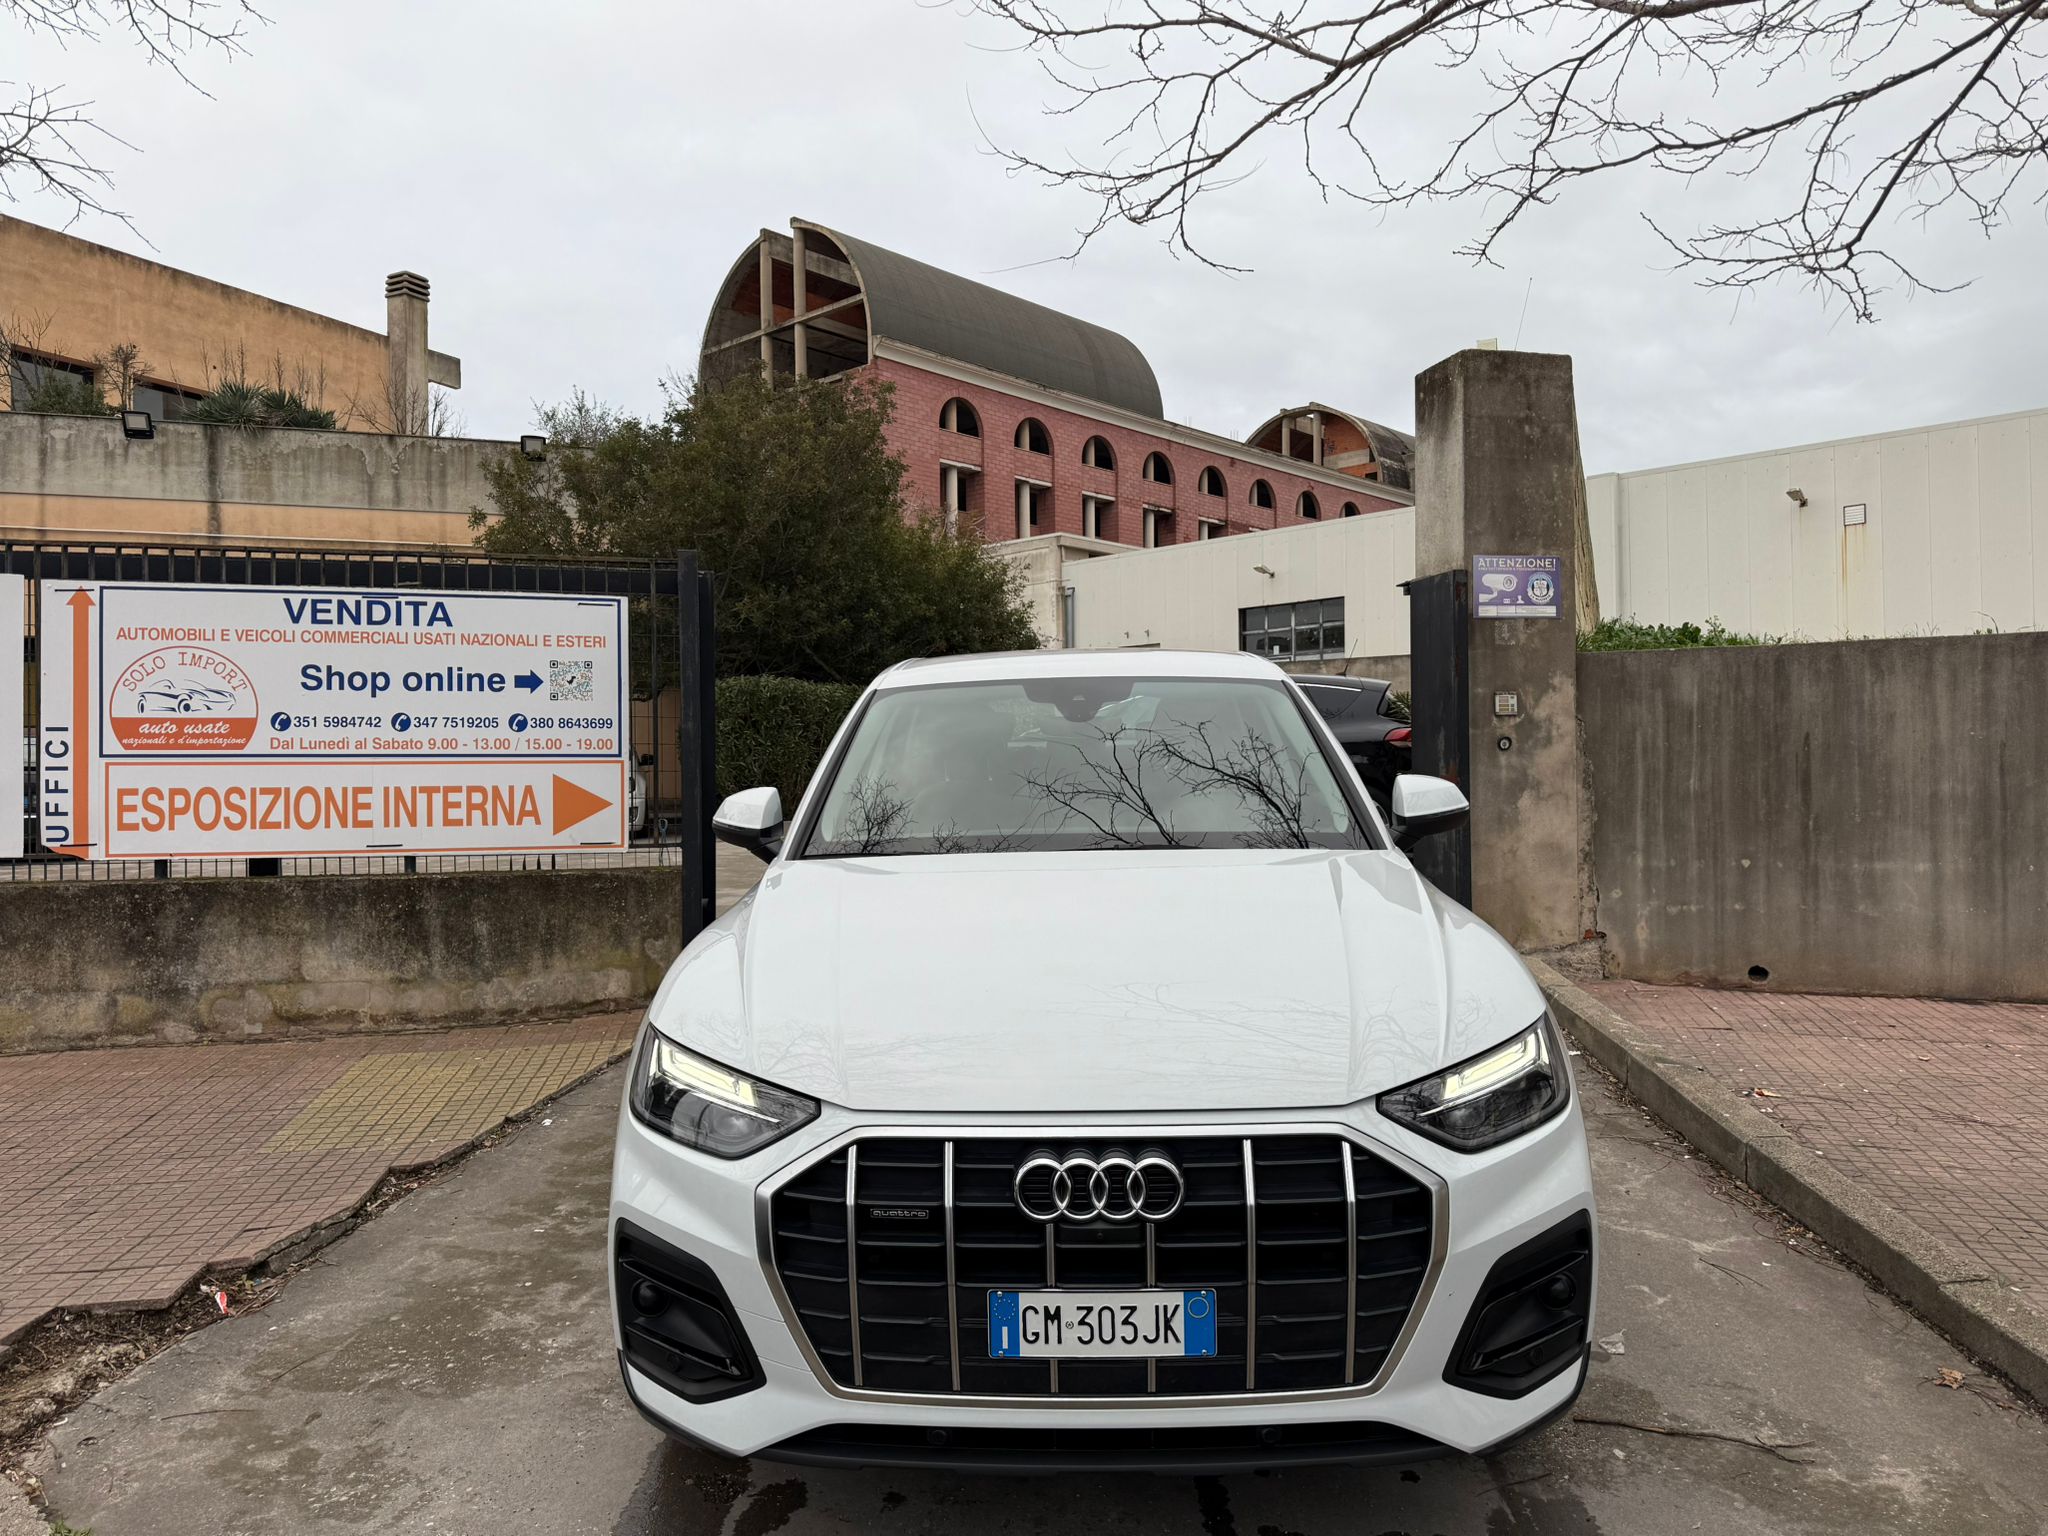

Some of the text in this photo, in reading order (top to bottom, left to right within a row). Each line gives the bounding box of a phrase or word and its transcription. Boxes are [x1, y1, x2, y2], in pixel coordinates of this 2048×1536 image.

[1478, 557, 1556, 571] ATTENZIONE!
[283, 598, 453, 627] VENDITA
[116, 627, 607, 648] AUTOMOBILI E VEICOLI COMMERCIALI USATI NAZIONALI E ESTERI
[122, 651, 248, 693] SOLO IMPORT
[300, 664, 506, 698] Shop online
[139, 720, 230, 734] auto usate
[293, 716, 382, 728] 351 5984742
[413, 716, 499, 728] 347 7519205
[530, 717, 613, 729] 380 8643699
[122, 735, 167, 747] nazionali
[177, 735, 246, 747] d'importazione
[270, 737, 294, 750] Dal
[300, 736, 350, 750] Lunedì
[355, 737, 367, 750] al
[372, 737, 423, 750] Sabato
[428, 737, 458, 750] 9.00
[473, 737, 511, 750] 13.00
[514, 737, 520, 752] /
[525, 737, 562, 750] 15.00
[576, 737, 613, 750] 19.00
[44, 726, 70, 843] UFFICI
[116, 784, 541, 832] ESPOSIZIONE INTERNA
[872, 1209, 926, 1218] quattro
[1021, 1304, 1181, 1344] GM 303JK
